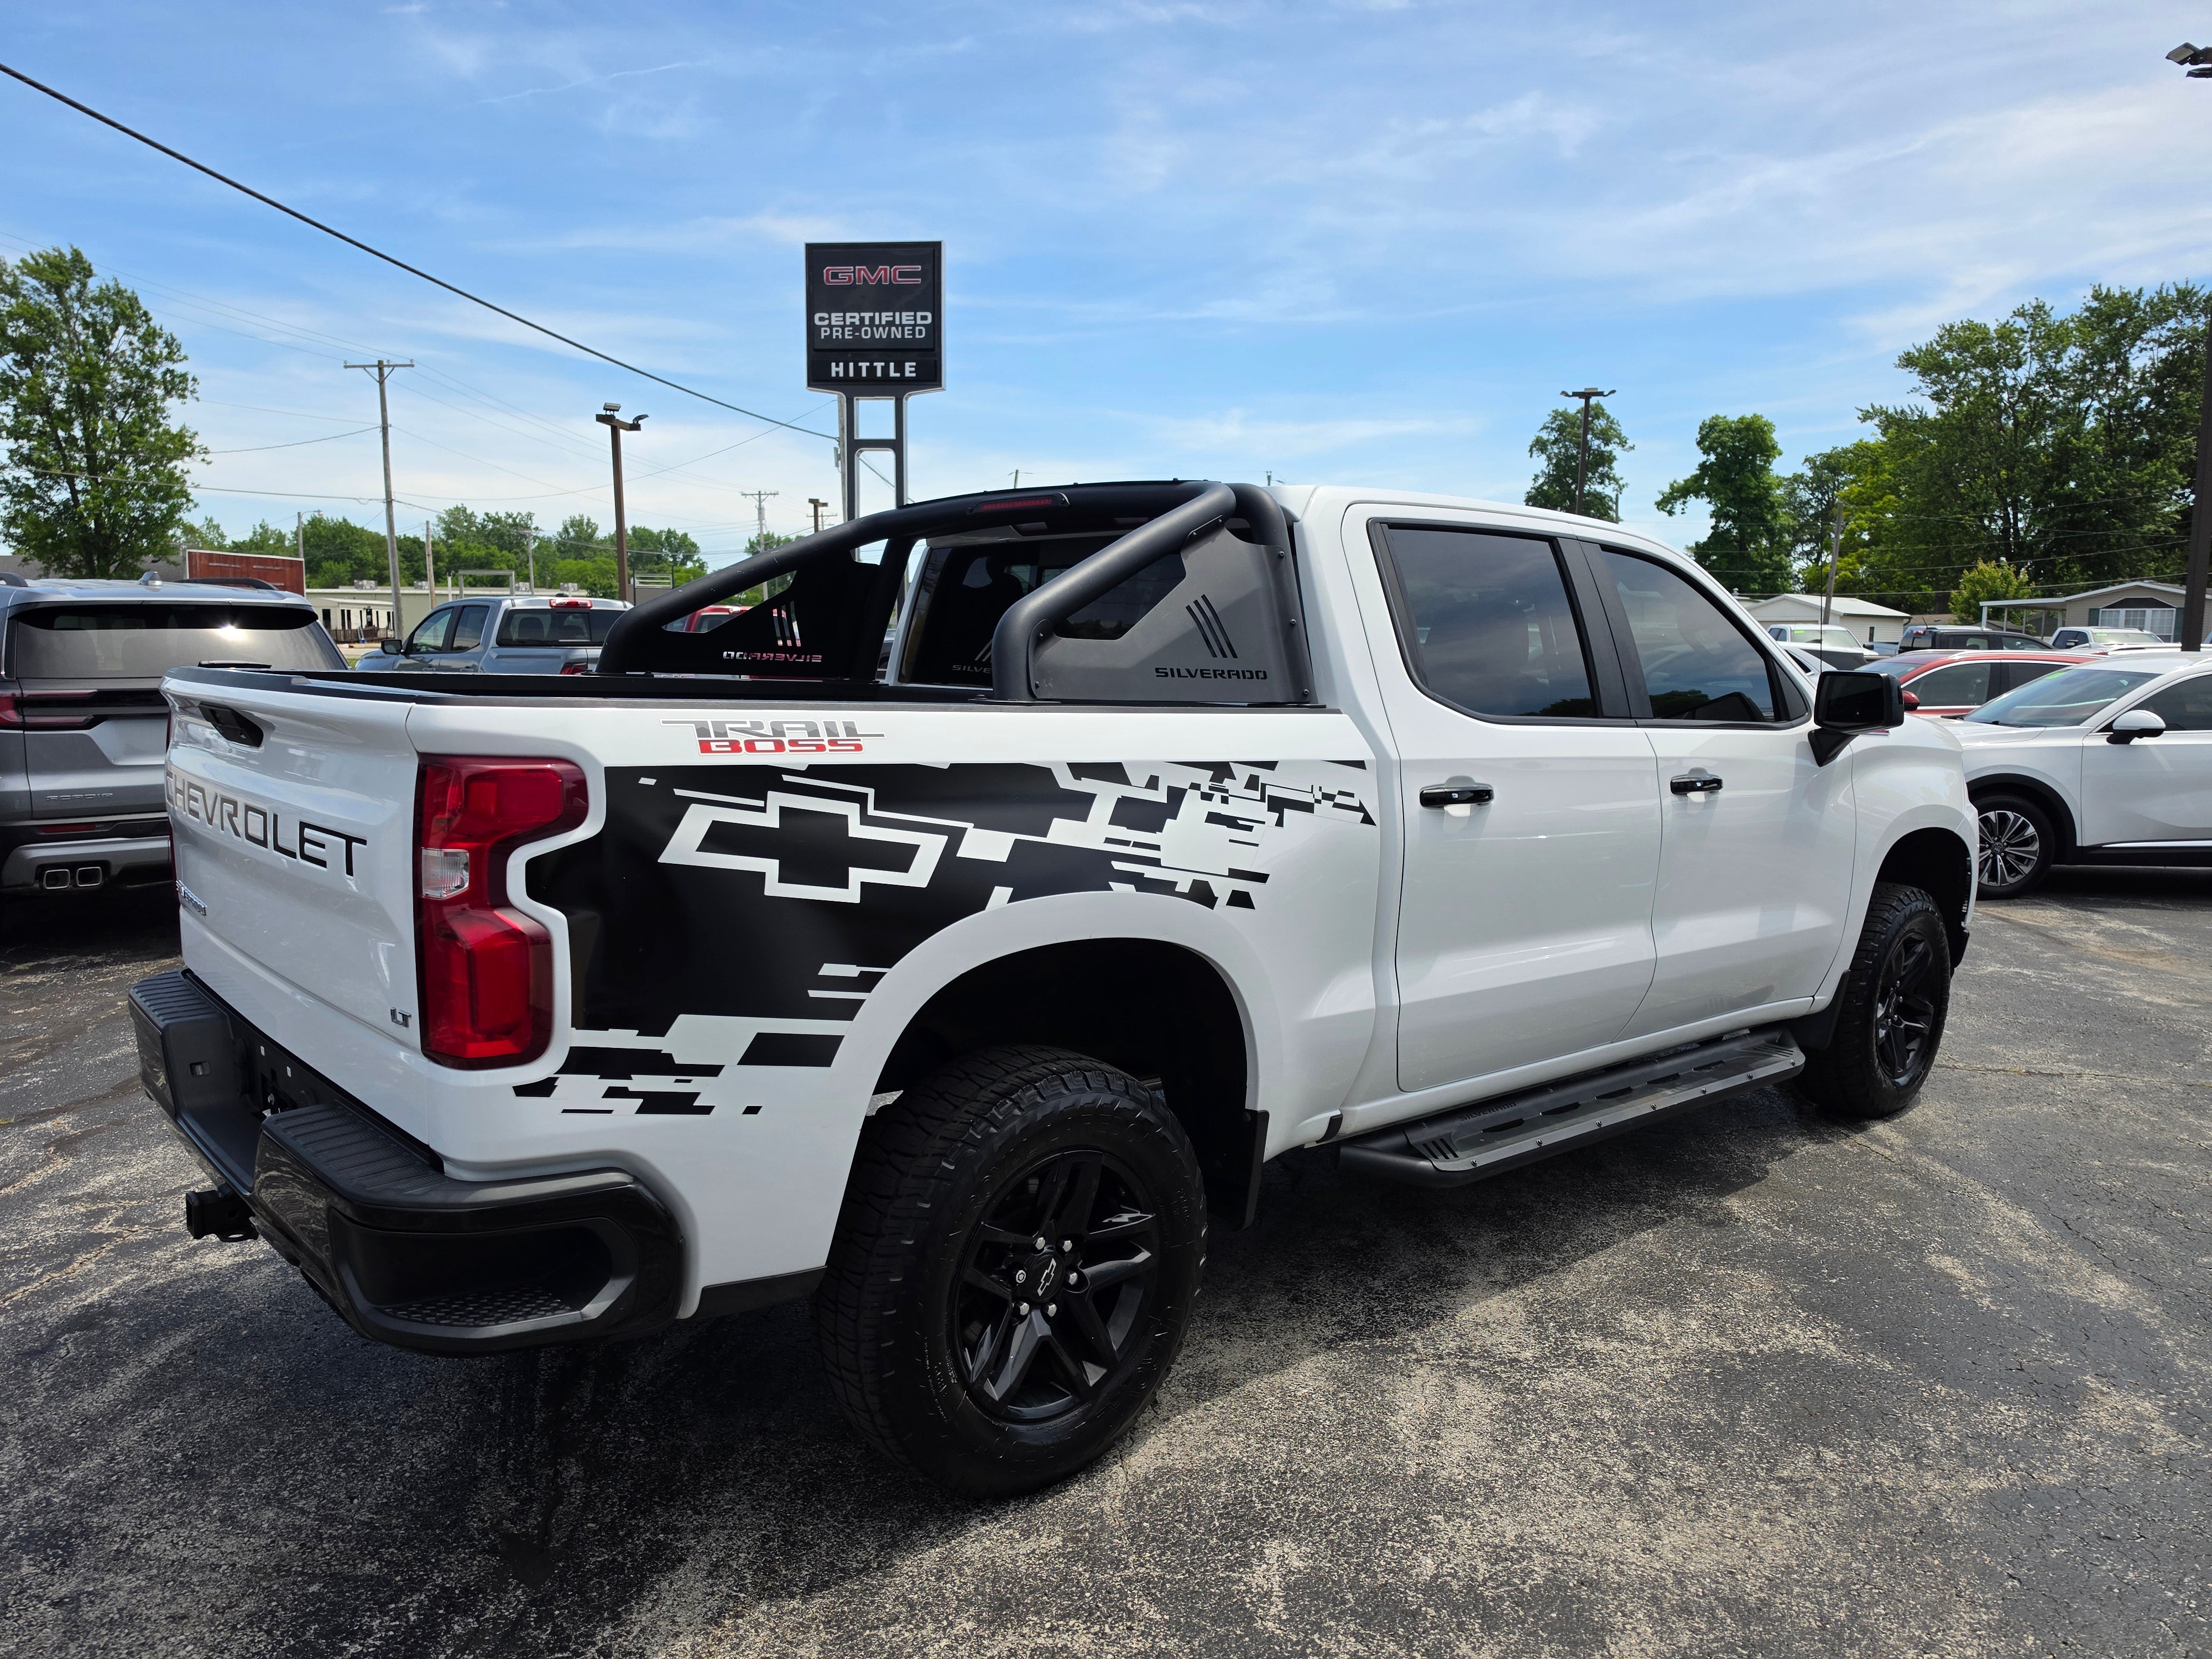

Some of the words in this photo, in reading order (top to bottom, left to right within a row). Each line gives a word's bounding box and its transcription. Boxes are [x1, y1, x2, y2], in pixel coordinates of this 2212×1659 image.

[823, 265, 921, 285] GMC
[814, 312, 932, 325] CERTIFIED
[821, 327, 926, 339] PRE-OWNED
[831, 362, 916, 377] HITTLE
[952, 665, 992, 674] SILVE
[1155, 667, 1267, 680] SILVERADO
[660, 719, 886, 738] TRAIL
[698, 738, 864, 754] BOSS
[166, 771, 367, 877] CHEVROLET
[390, 1007, 411, 1027] LT
[1460, 1102, 1517, 1121] SILVERADO
